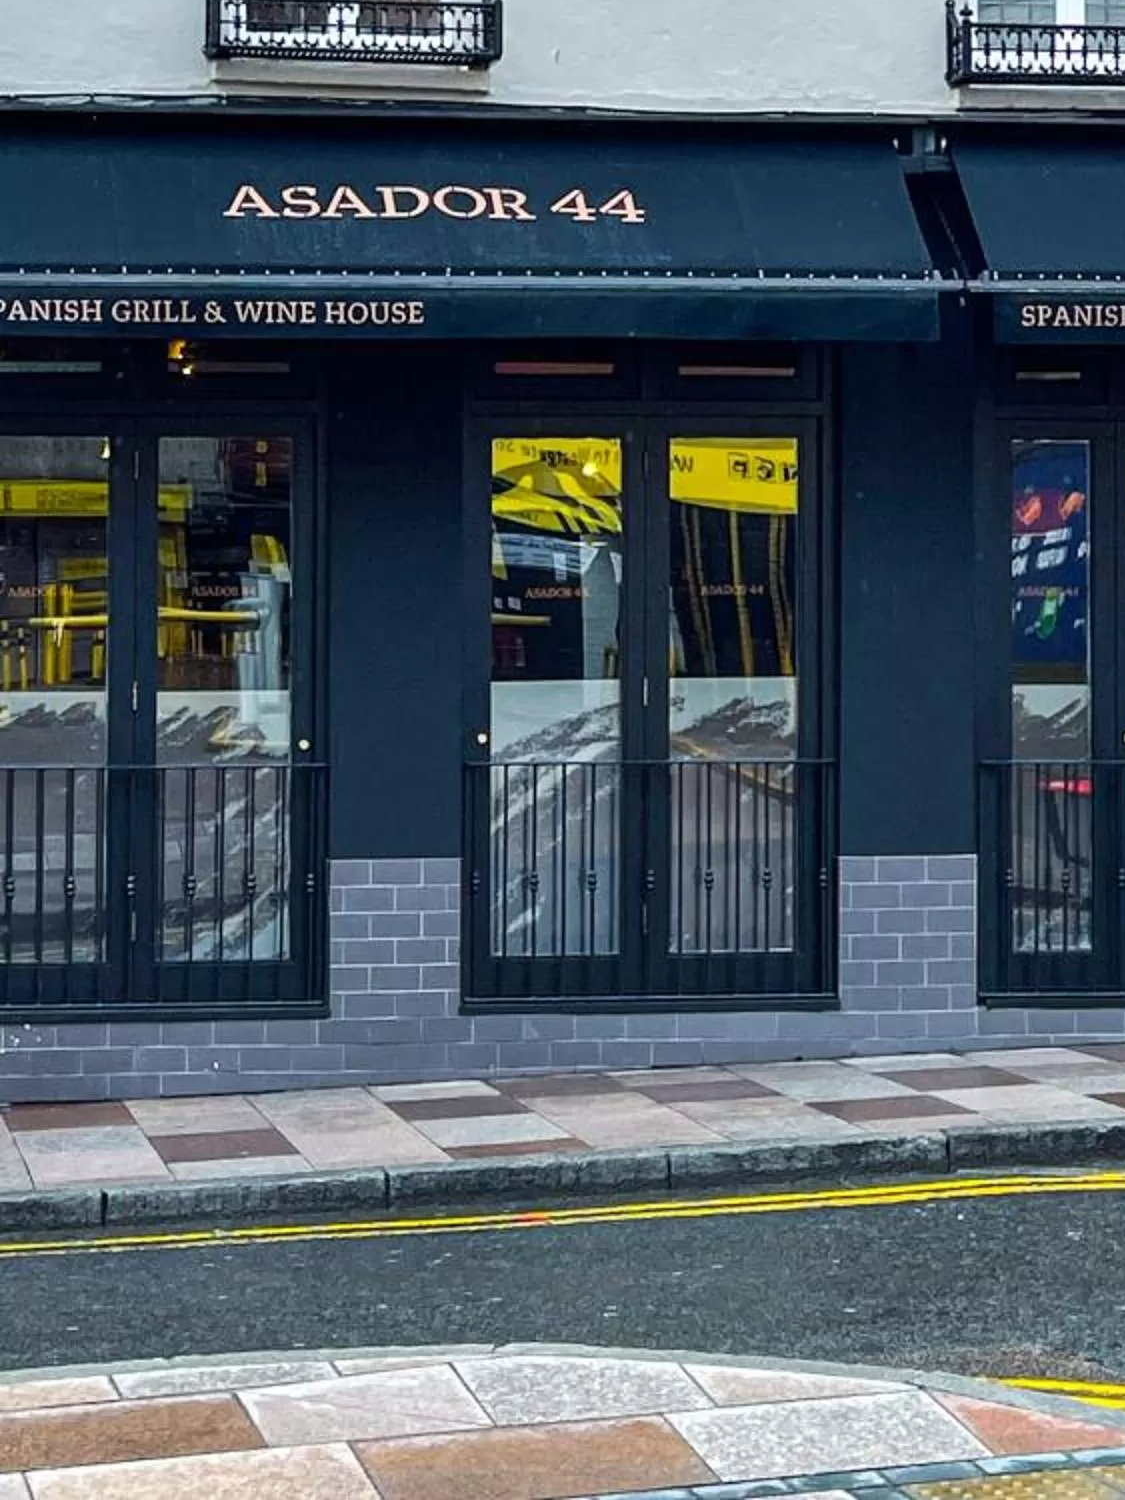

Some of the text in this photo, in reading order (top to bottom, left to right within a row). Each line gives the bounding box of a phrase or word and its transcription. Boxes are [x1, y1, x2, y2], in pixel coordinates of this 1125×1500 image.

[223, 185, 645, 223] ASADOR 44
[111, 299, 197, 323] GRILL
[203, 300, 227, 323] &
[233, 300, 317, 324] WINE
[324, 301, 425, 325] HOUSE
